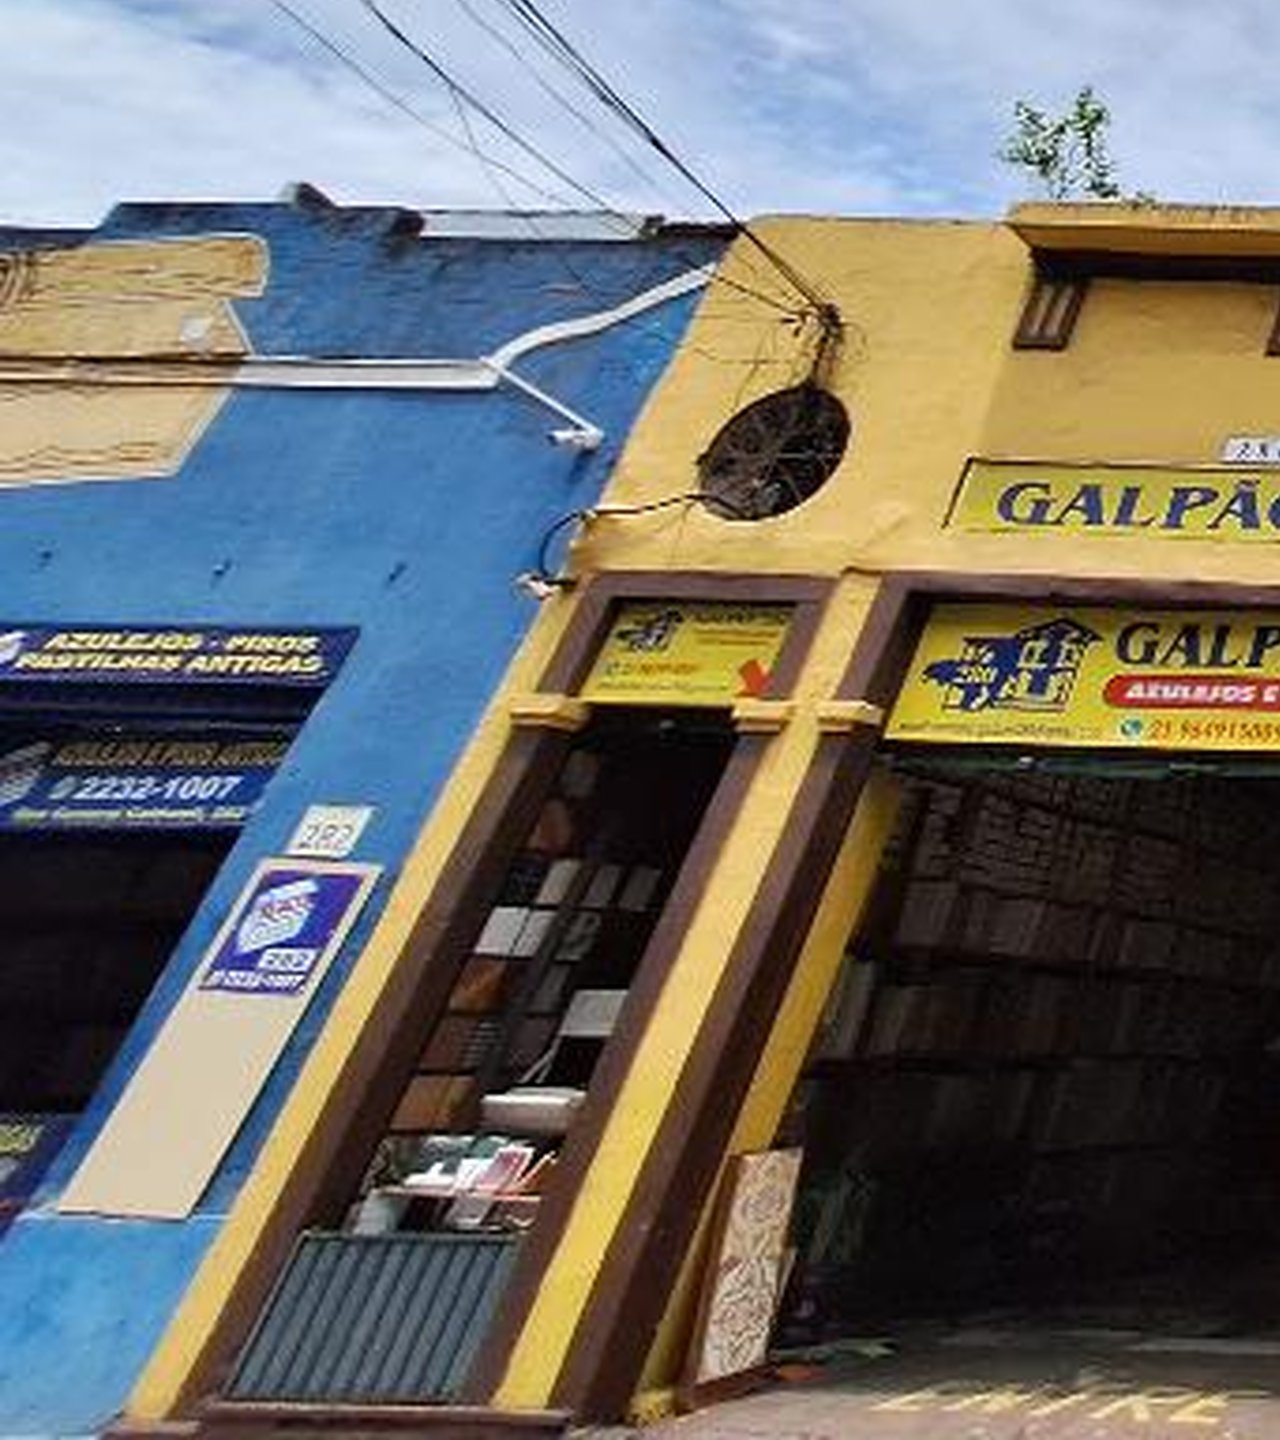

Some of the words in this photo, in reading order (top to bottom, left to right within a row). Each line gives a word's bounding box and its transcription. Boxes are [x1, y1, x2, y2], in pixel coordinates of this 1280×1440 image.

[45, 633, 204, 651] AZULEJOS
[184, 656, 324, 674] ANTIGAS
[1262, 685, 1279, 703] E
[72, 775, 245, 801] 2232-1007
